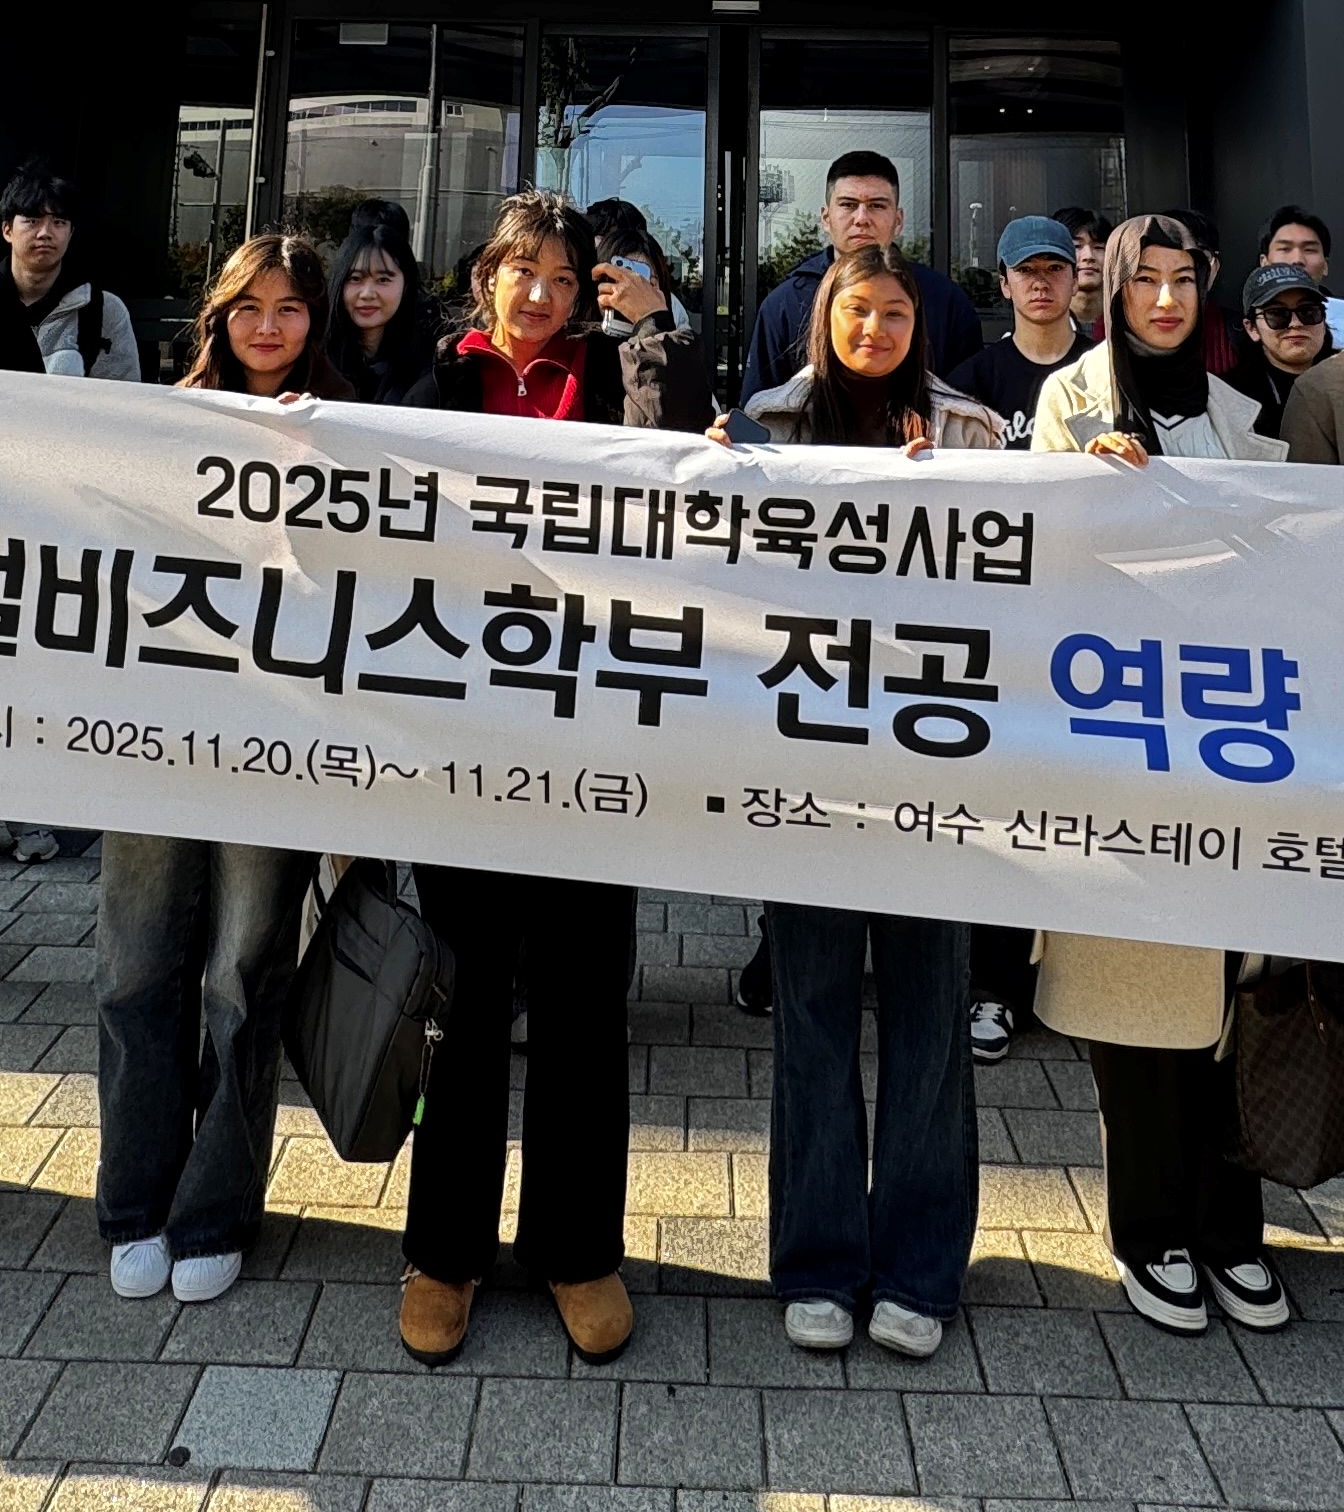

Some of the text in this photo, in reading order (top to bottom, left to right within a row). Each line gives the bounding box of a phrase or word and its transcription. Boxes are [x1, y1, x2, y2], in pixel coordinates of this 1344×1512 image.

[196, 456, 1034, 586] 2025년 국립대학육성사업
[756, 614, 999, 759] 전공
[1051, 634, 1301, 783] 역량
[442, 760, 649, 818] 11.21.(금)
[741, 785, 832, 830] 장소
[894, 801, 984, 848] 여수
[1005, 809, 1242, 872] 신라스테이
